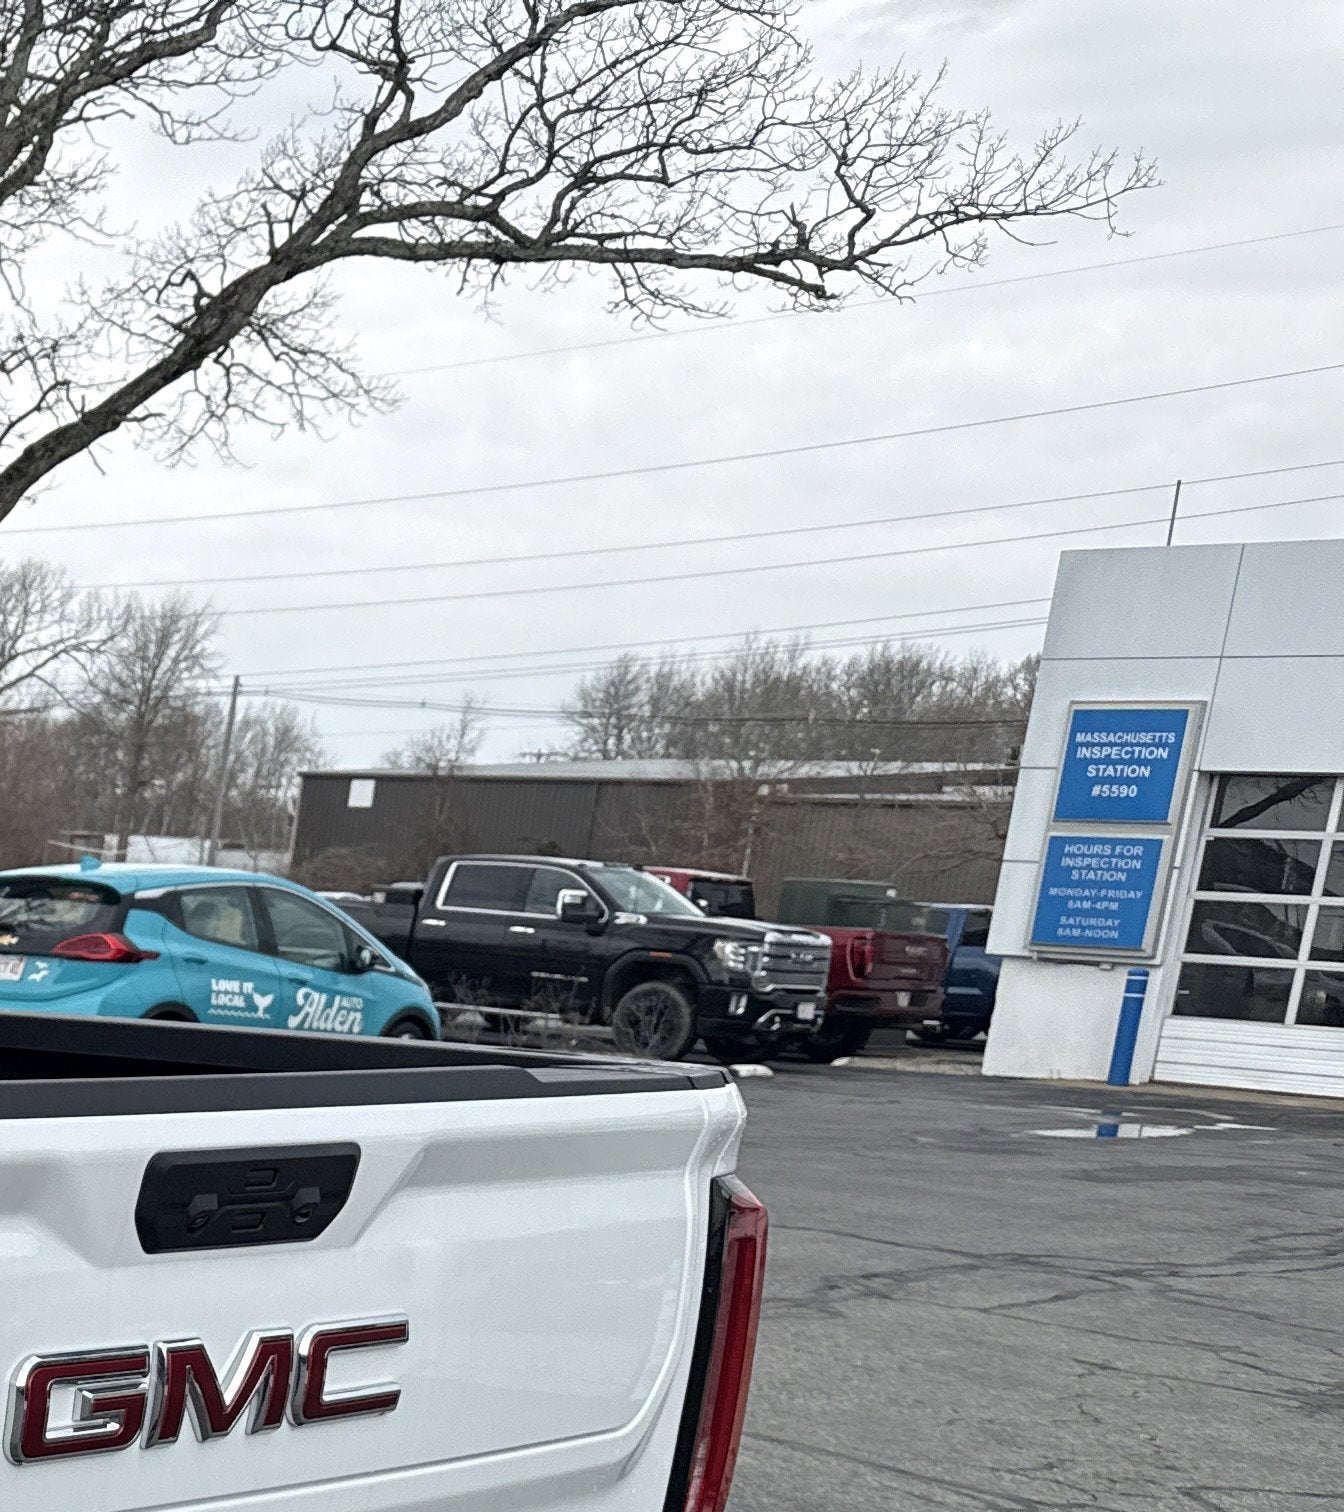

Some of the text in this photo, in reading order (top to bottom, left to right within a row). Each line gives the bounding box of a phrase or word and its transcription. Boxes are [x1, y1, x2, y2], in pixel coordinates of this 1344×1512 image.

[1075, 732, 1176, 743] MASSACHUSETTS
[1076, 746, 1169, 759] INSPECTION
[1086, 764, 1151, 778] STATION
[1091, 784, 1138, 798] #5590
[1064, 844, 1144, 857] HOURS FOR
[1060, 856, 1143, 869] INSPECTION
[1070, 869, 1127, 882] STATION
[1059, 915, 1121, 927] SATURDAY
[211, 978, 255, 994] LOVE IT
[211, 993, 246, 1007] LOCAL
[341, 997, 363, 1007] AUTO
[288, 987, 363, 1034] Alden
[3, 1313, 410, 1465] GMC
